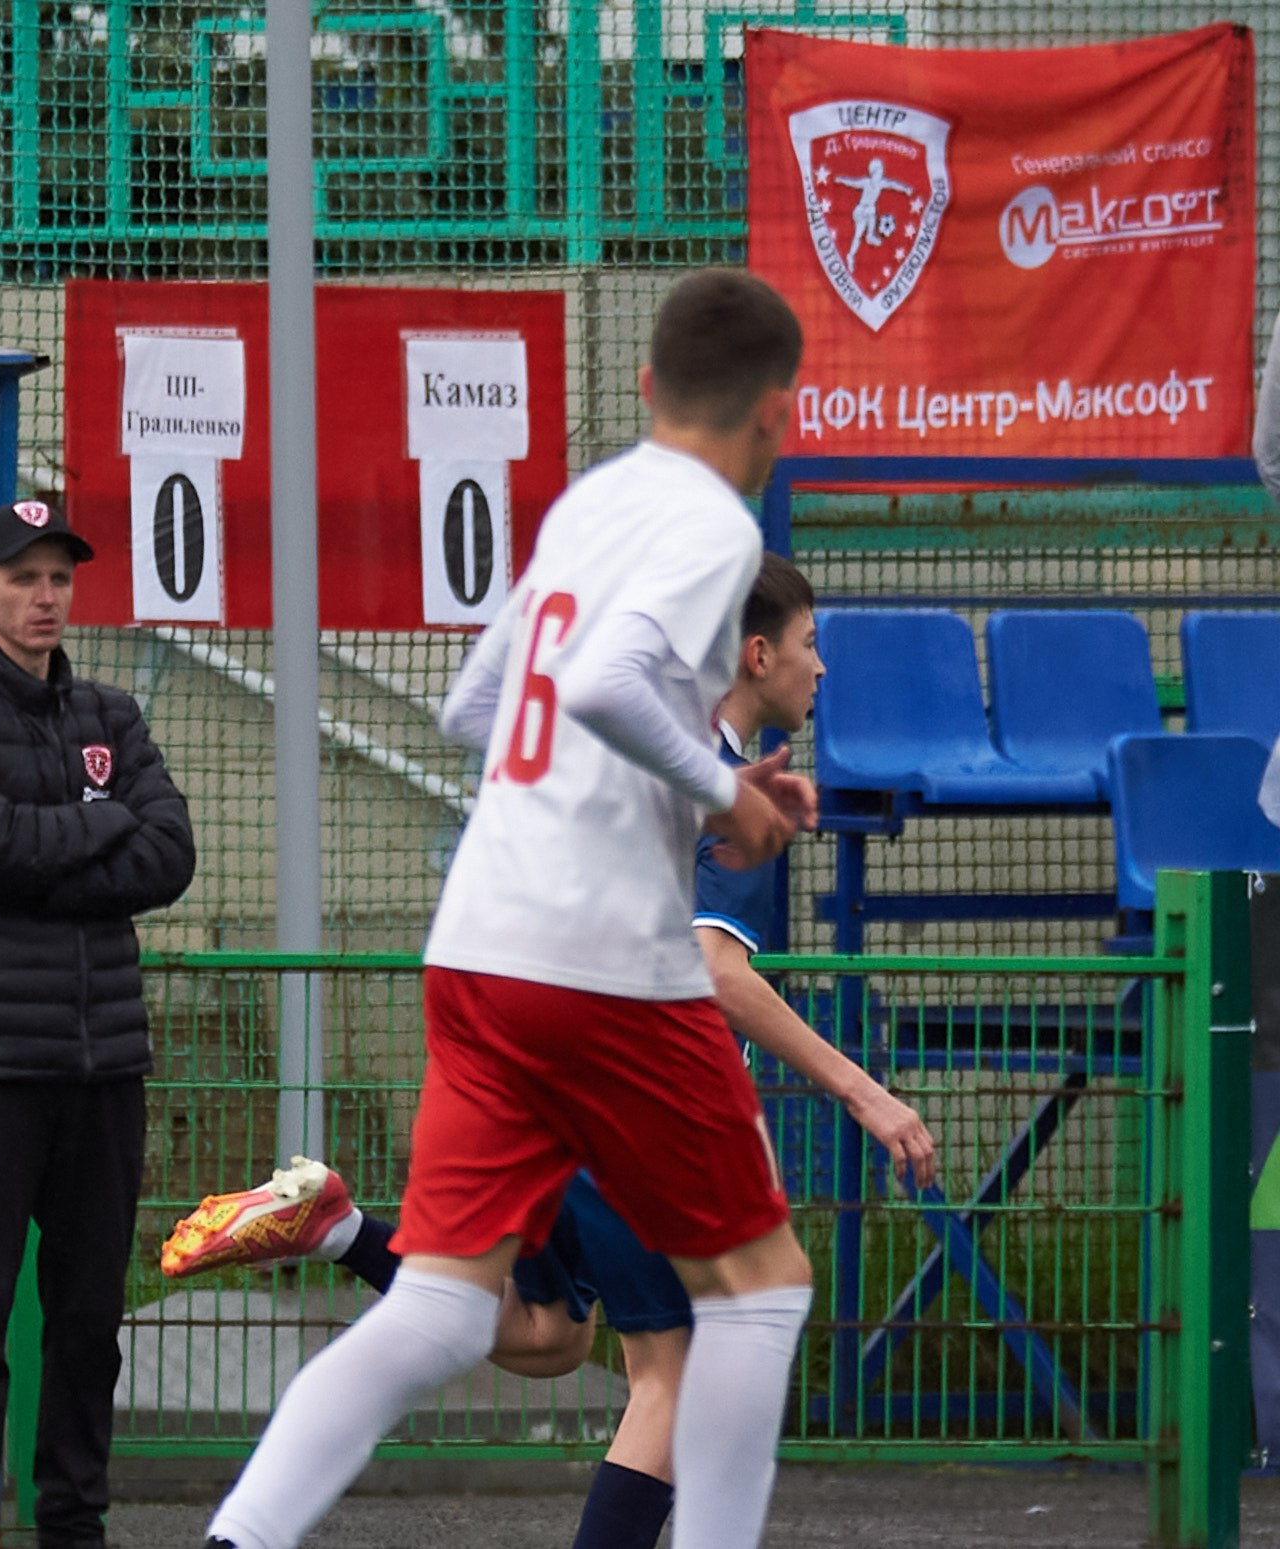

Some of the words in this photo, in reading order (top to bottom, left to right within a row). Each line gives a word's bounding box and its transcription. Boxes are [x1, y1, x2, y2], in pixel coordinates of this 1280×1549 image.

[838, 104, 907, 131] ЦЕНТР
[881, 177, 947, 311] ФУТБОЛИСТОВ
[166, 374, 205, 400] ЦП-
[422, 373, 519, 408] Камаз
[798, 385, 886, 439] ДФК
[897, 370, 1215, 438] Центр-Максофт
[125, 410, 242, 439] Градиленко
[153, 472, 205, 604] 0
[443, 478, 494, 607] 0
[488, 589, 578, 787] 6
